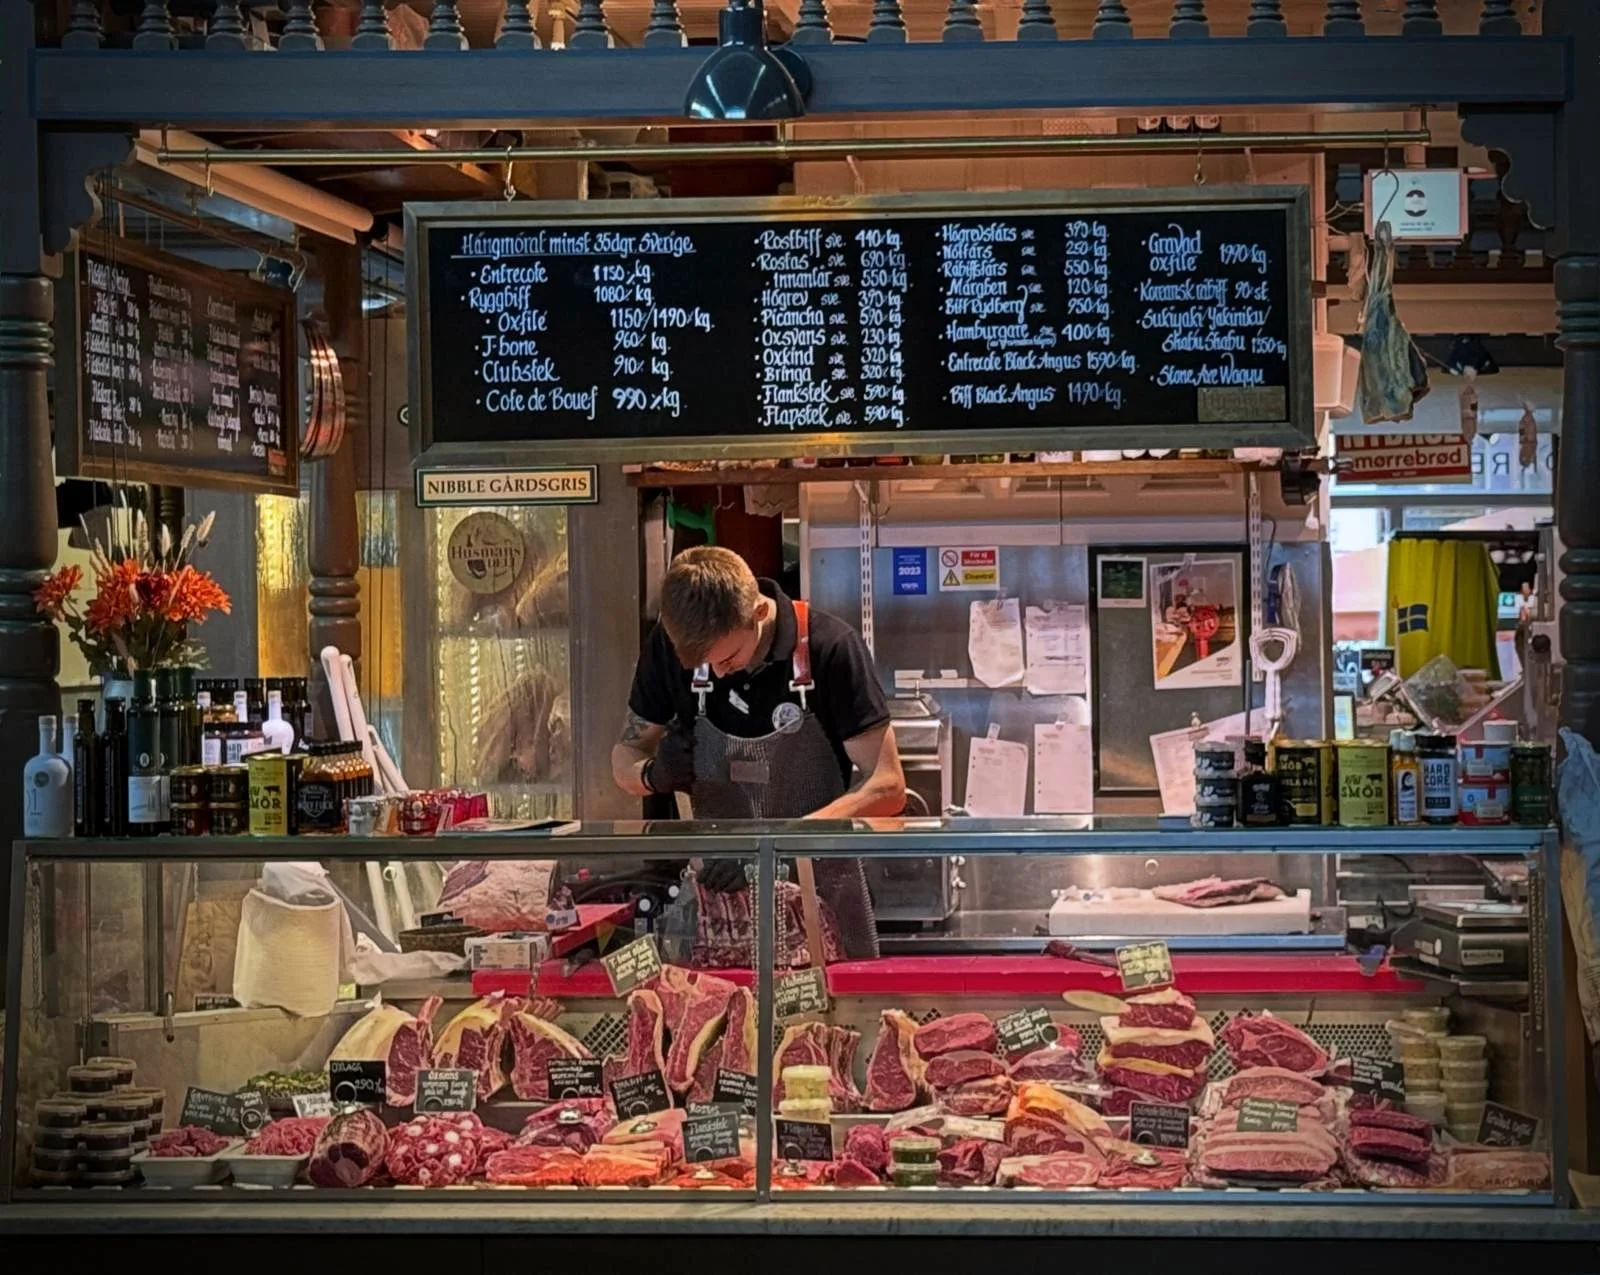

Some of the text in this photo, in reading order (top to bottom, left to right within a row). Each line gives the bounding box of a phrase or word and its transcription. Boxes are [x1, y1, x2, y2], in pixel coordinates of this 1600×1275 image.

[550, 231, 591, 254] minst
[639, 230, 693, 258] Sverige
[760, 228, 822, 257] Rostbiff
[1148, 223, 1202, 255] Gravad
[480, 261, 548, 284] Entrecote
[468, 284, 531, 313] Ryggbiff
[498, 309, 547, 335] Oxfilé
[945, 319, 1030, 342] Hamburgare
[762, 327, 826, 346] Oxsvans
[1161, 329, 1204, 352] Shabu
[1204, 330, 1246, 351] Shabu
[763, 346, 814, 366] Oxkind
[1003, 350, 1037, 371] Black
[1037, 354, 1082, 373] Angus
[482, 358, 560, 383] Clubstek
[763, 366, 812, 386] Bringa
[1156, 364, 1195, 387] Stone
[1219, 351, 1265, 388] Wagyu
[486, 391, 524, 412] Cote
[527, 391, 547, 412] de
[548, 385, 598, 420] Bouef
[949, 384, 973, 410] Biff
[976, 384, 1008, 405] Black
[1007, 383, 1056, 410] Angus
[427, 475, 588, 495] NIBBLE GÅRDSGRIS
[1423, 763, 1450, 776] HARD
[1423, 775, 1450, 786] CORE
